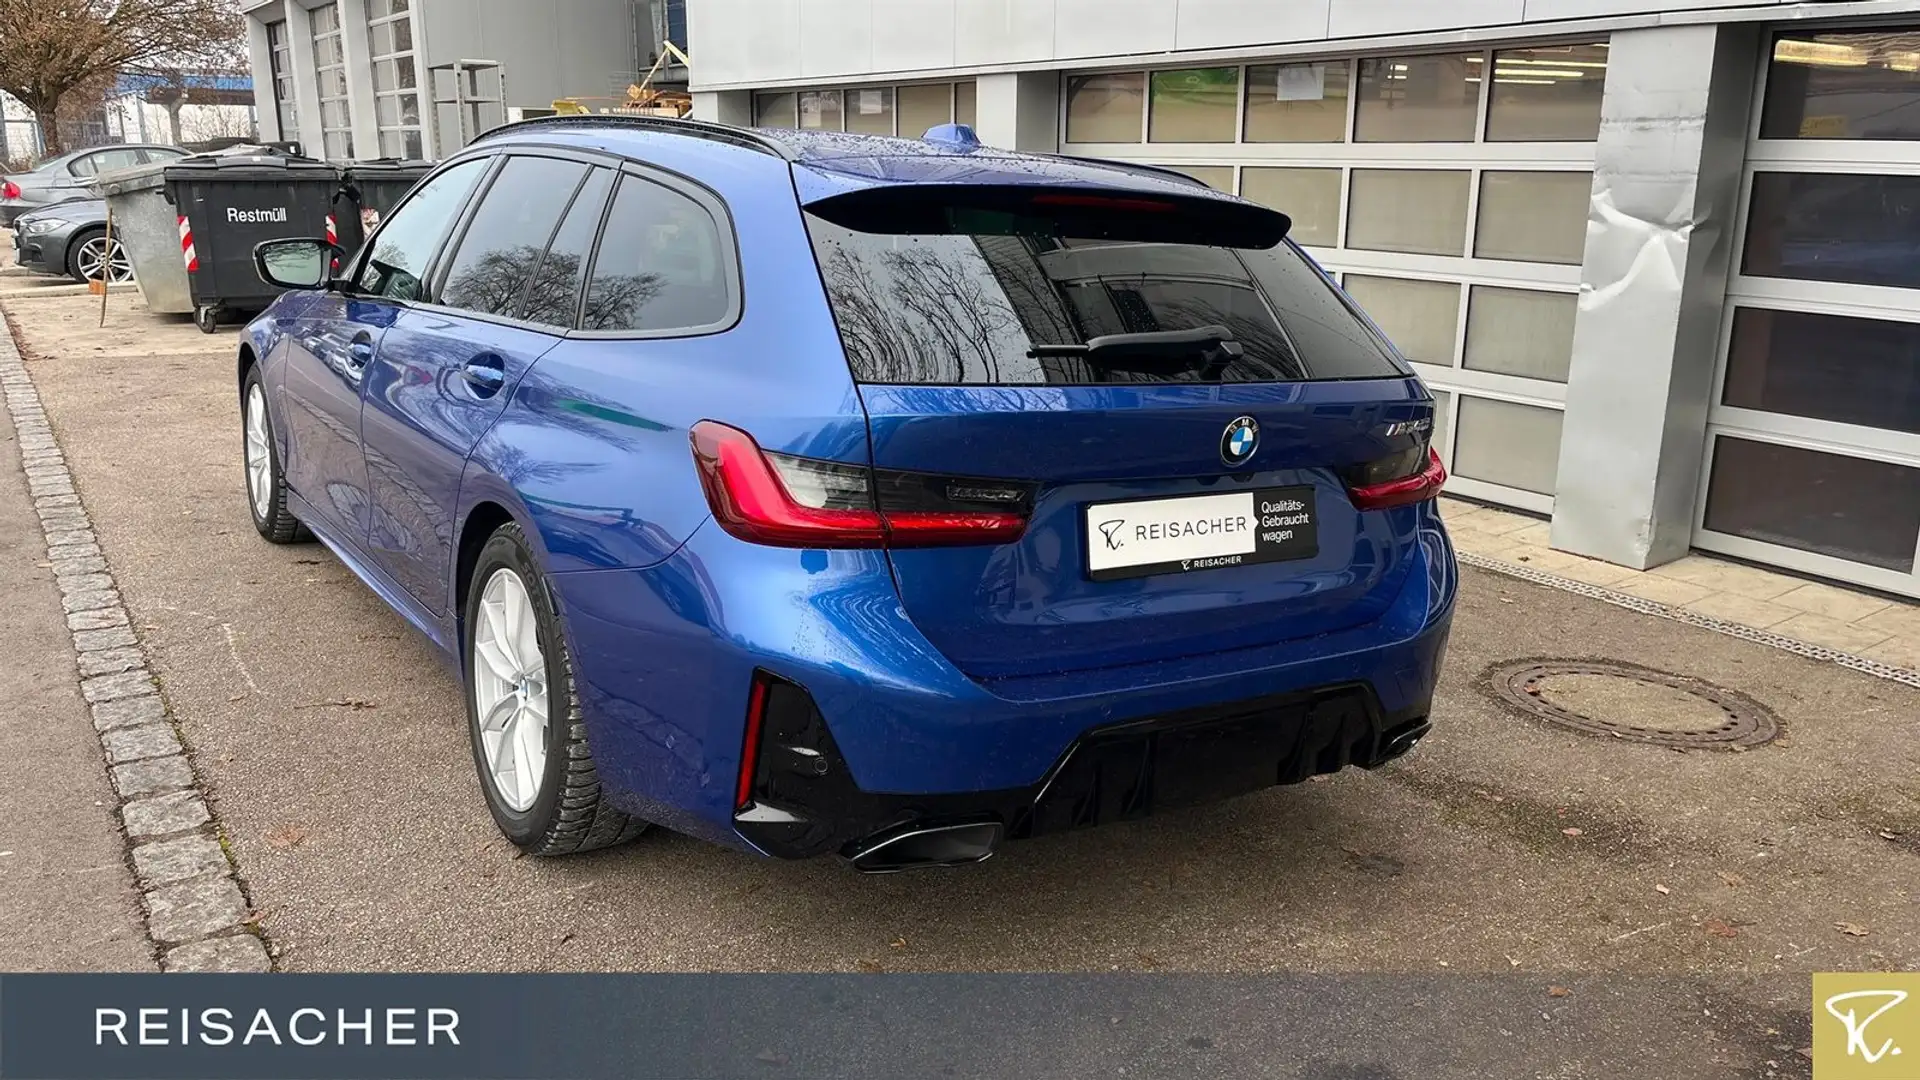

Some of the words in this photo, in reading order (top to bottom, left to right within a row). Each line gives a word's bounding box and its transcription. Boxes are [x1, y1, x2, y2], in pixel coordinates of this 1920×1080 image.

[226, 207, 287, 223] Restmüll
[1261, 499, 1305, 514] Qualitäts-
[1262, 513, 1309, 528] Gebraucht
[1135, 516, 1248, 541] REISACHER
[1262, 529, 1294, 543] wagen
[1193, 555, 1242, 569] REISACHER
